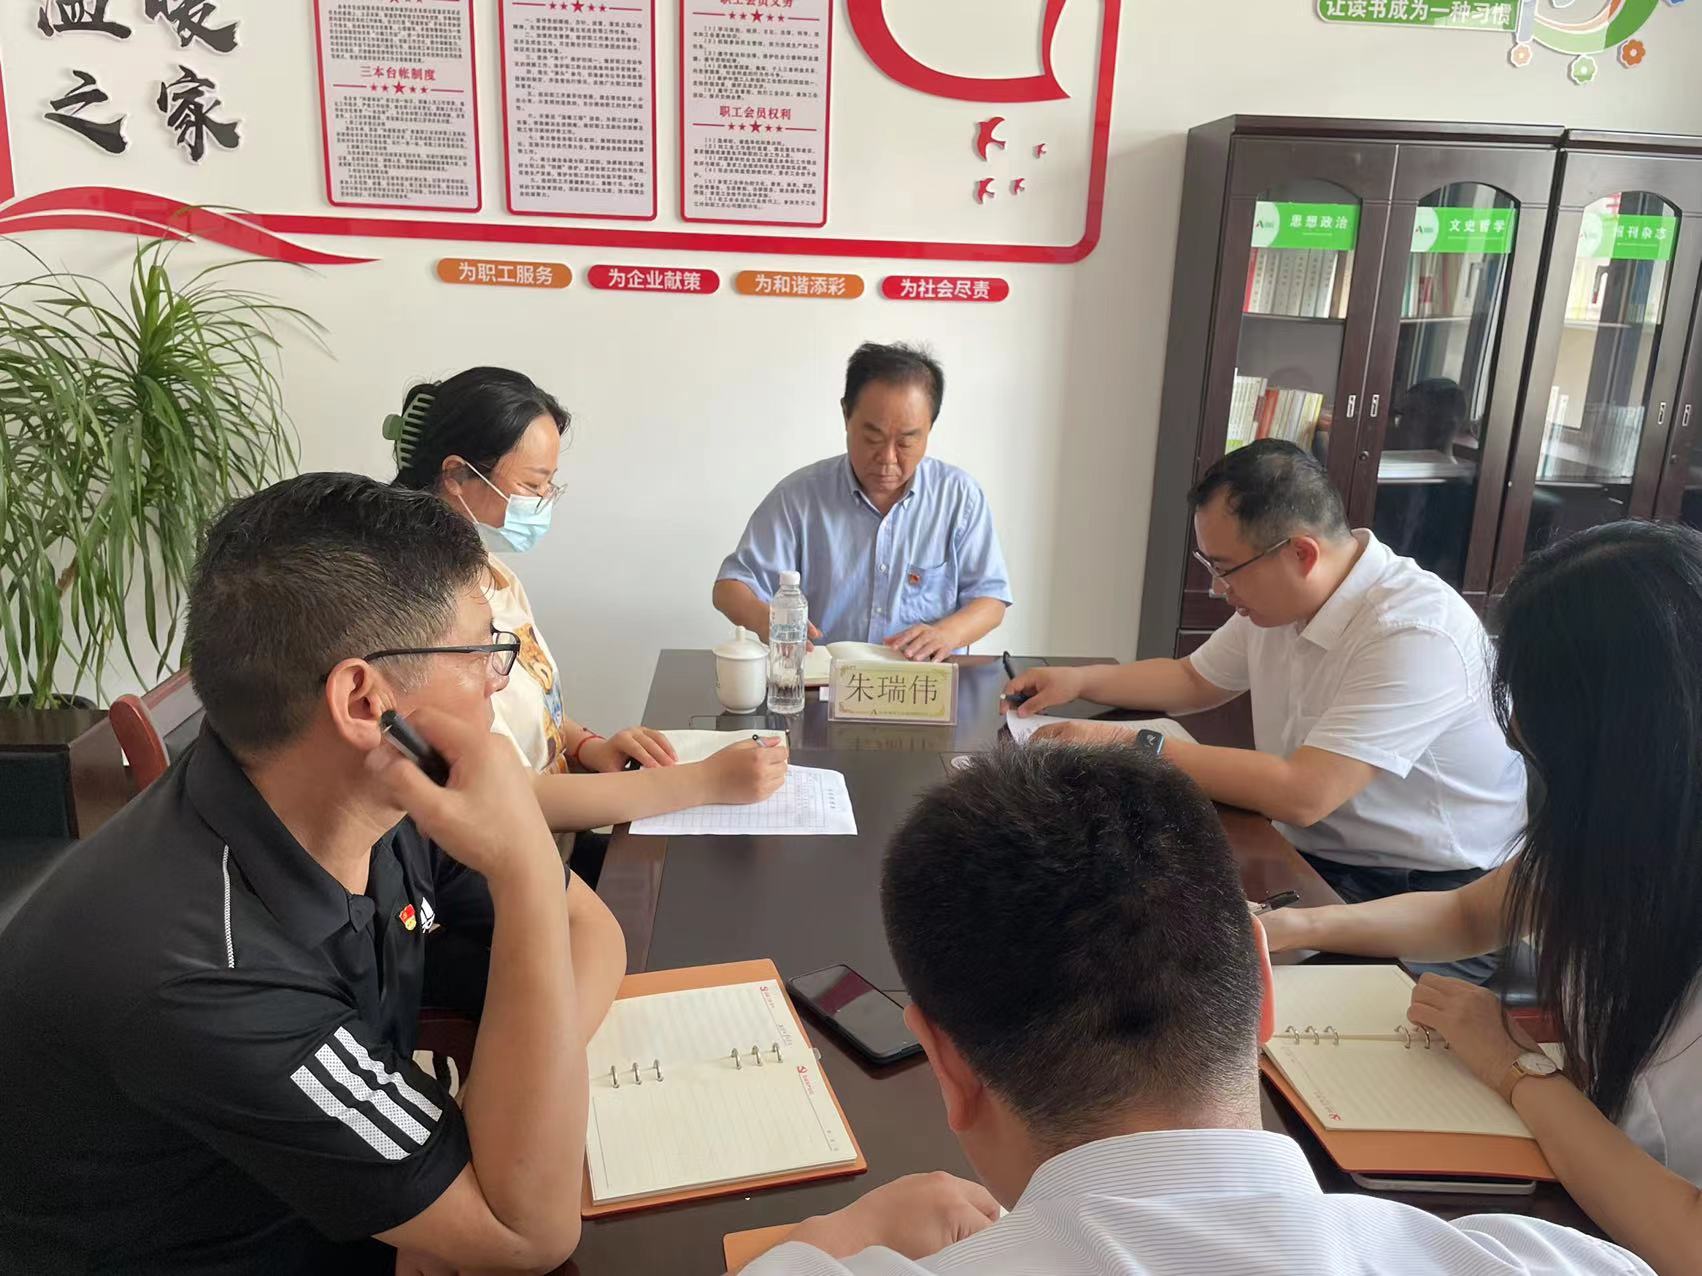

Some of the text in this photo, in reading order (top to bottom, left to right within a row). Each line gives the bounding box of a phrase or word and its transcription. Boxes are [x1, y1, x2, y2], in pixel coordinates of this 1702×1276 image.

[1326, 0, 1512, 25] 让读书成为一种习惯
[44, 65, 241, 162] 之家
[720, 106, 791, 120] 职工会员权利
[1290, 214, 1349, 229] 思想政治
[1449, 218, 1505, 233] 文史哲学
[458, 262, 553, 285] 为职工服务
[608, 268, 701, 291] 为企业献策
[755, 274, 847, 296] 为和谐添彩
[900, 279, 990, 299] 为社会尽责
[845, 672, 939, 704] 朱瑞伟
